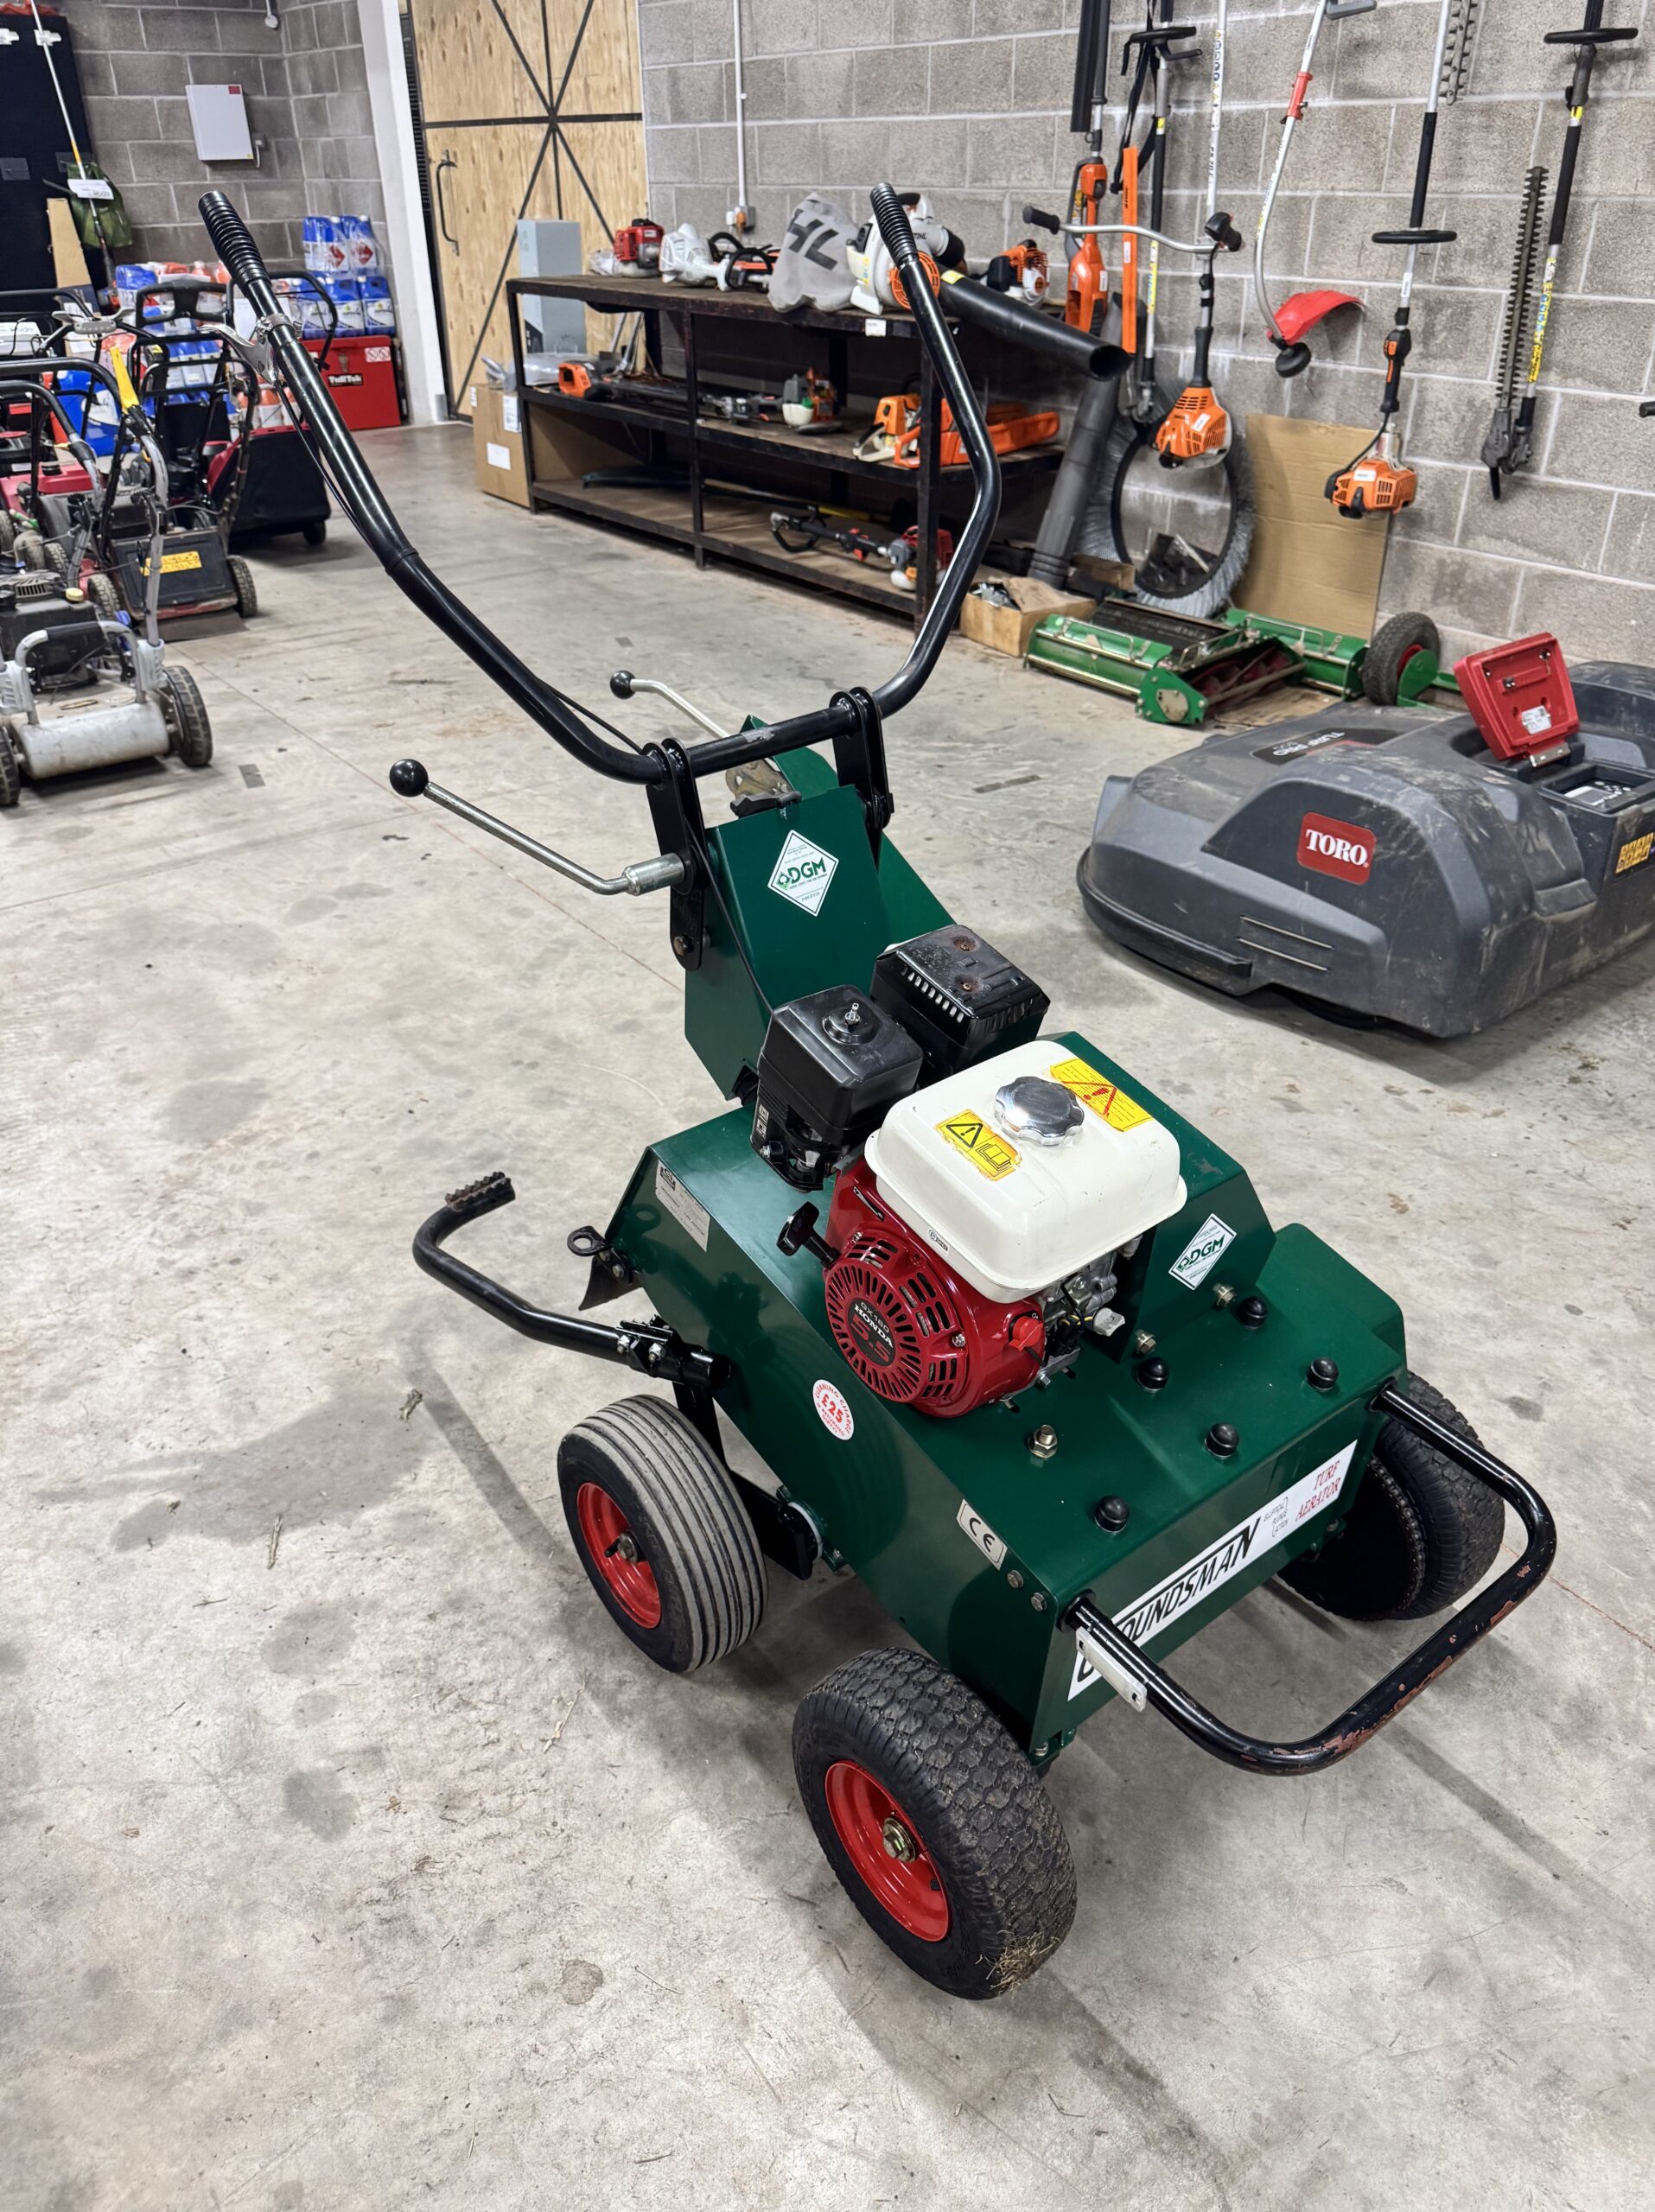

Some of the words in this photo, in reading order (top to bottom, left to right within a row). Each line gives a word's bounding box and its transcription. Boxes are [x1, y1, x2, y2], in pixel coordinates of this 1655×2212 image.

[1305, 828, 1368, 867] TORO
[787, 855, 827, 885] DGM
[1188, 1233, 1225, 1266] DGM
[853, 1303, 894, 1349] HONDA
[860, 1300, 890, 1334] GX160
[850, 1313, 891, 1363] 5.5
[821, 1393, 843, 1423] £25
[1313, 1459, 1340, 1491] TURF
[1295, 1477, 1341, 1522] AERATOR
[969, 1516, 996, 1554] CE
